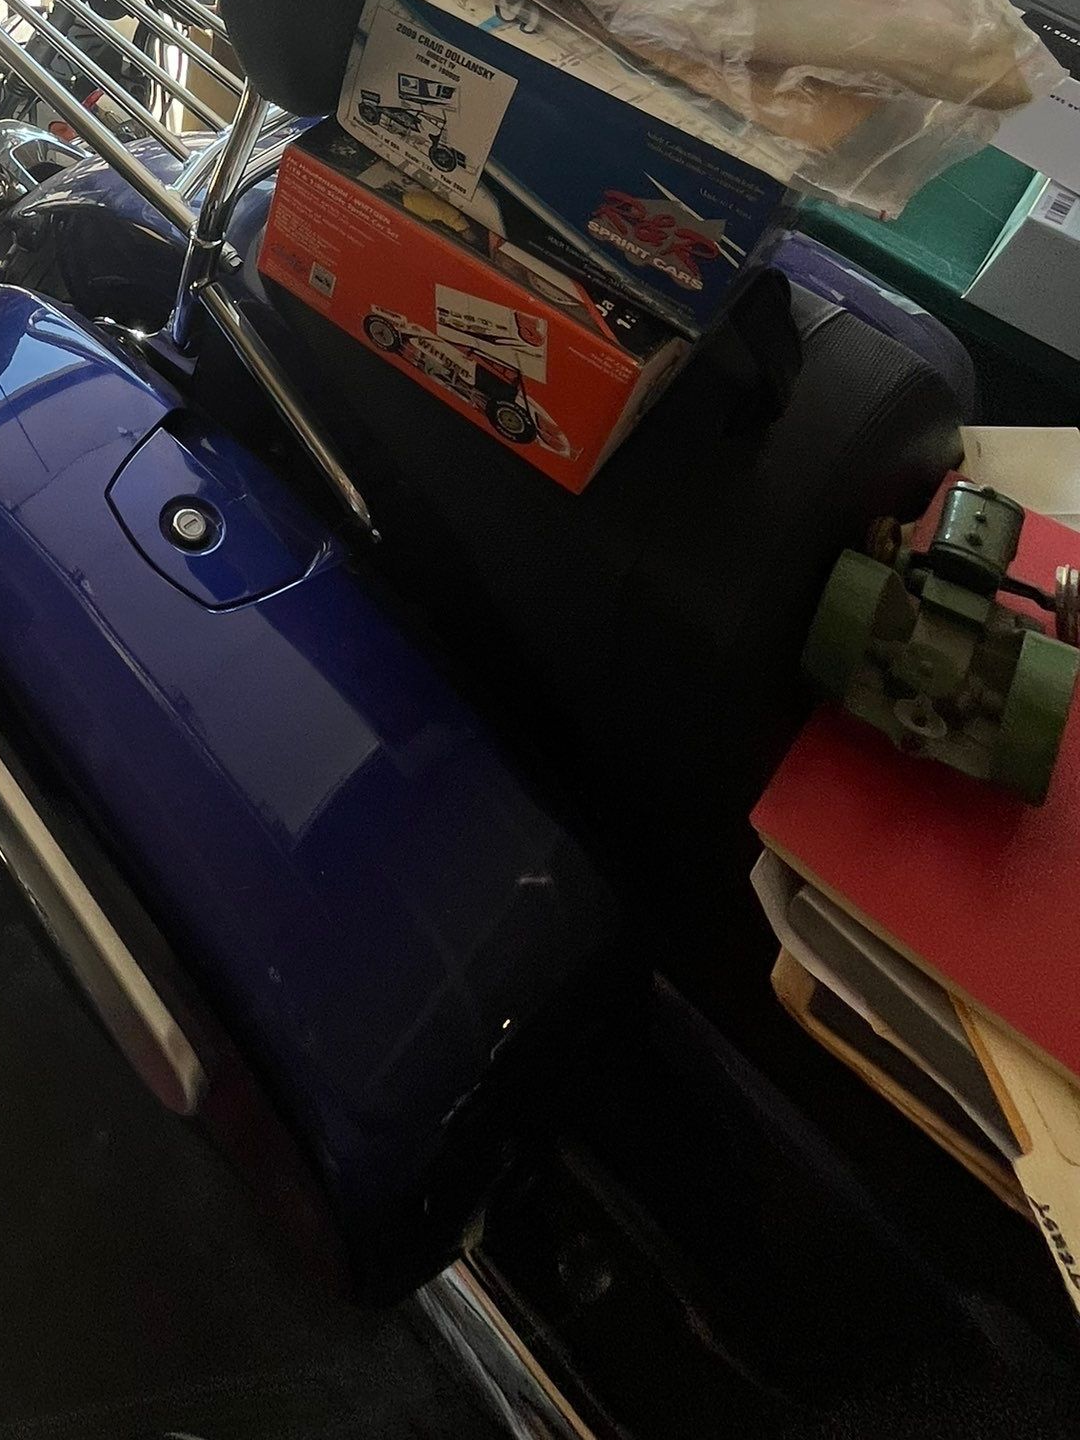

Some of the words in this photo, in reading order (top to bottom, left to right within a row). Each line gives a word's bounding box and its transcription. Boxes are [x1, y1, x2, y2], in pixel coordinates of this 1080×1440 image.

[417, 34, 444, 54] CRAIG
[444, 48, 495, 80] DOLLANSKY
[586, 221, 649, 260] SPRINT
[653, 257, 703, 290] CARS
